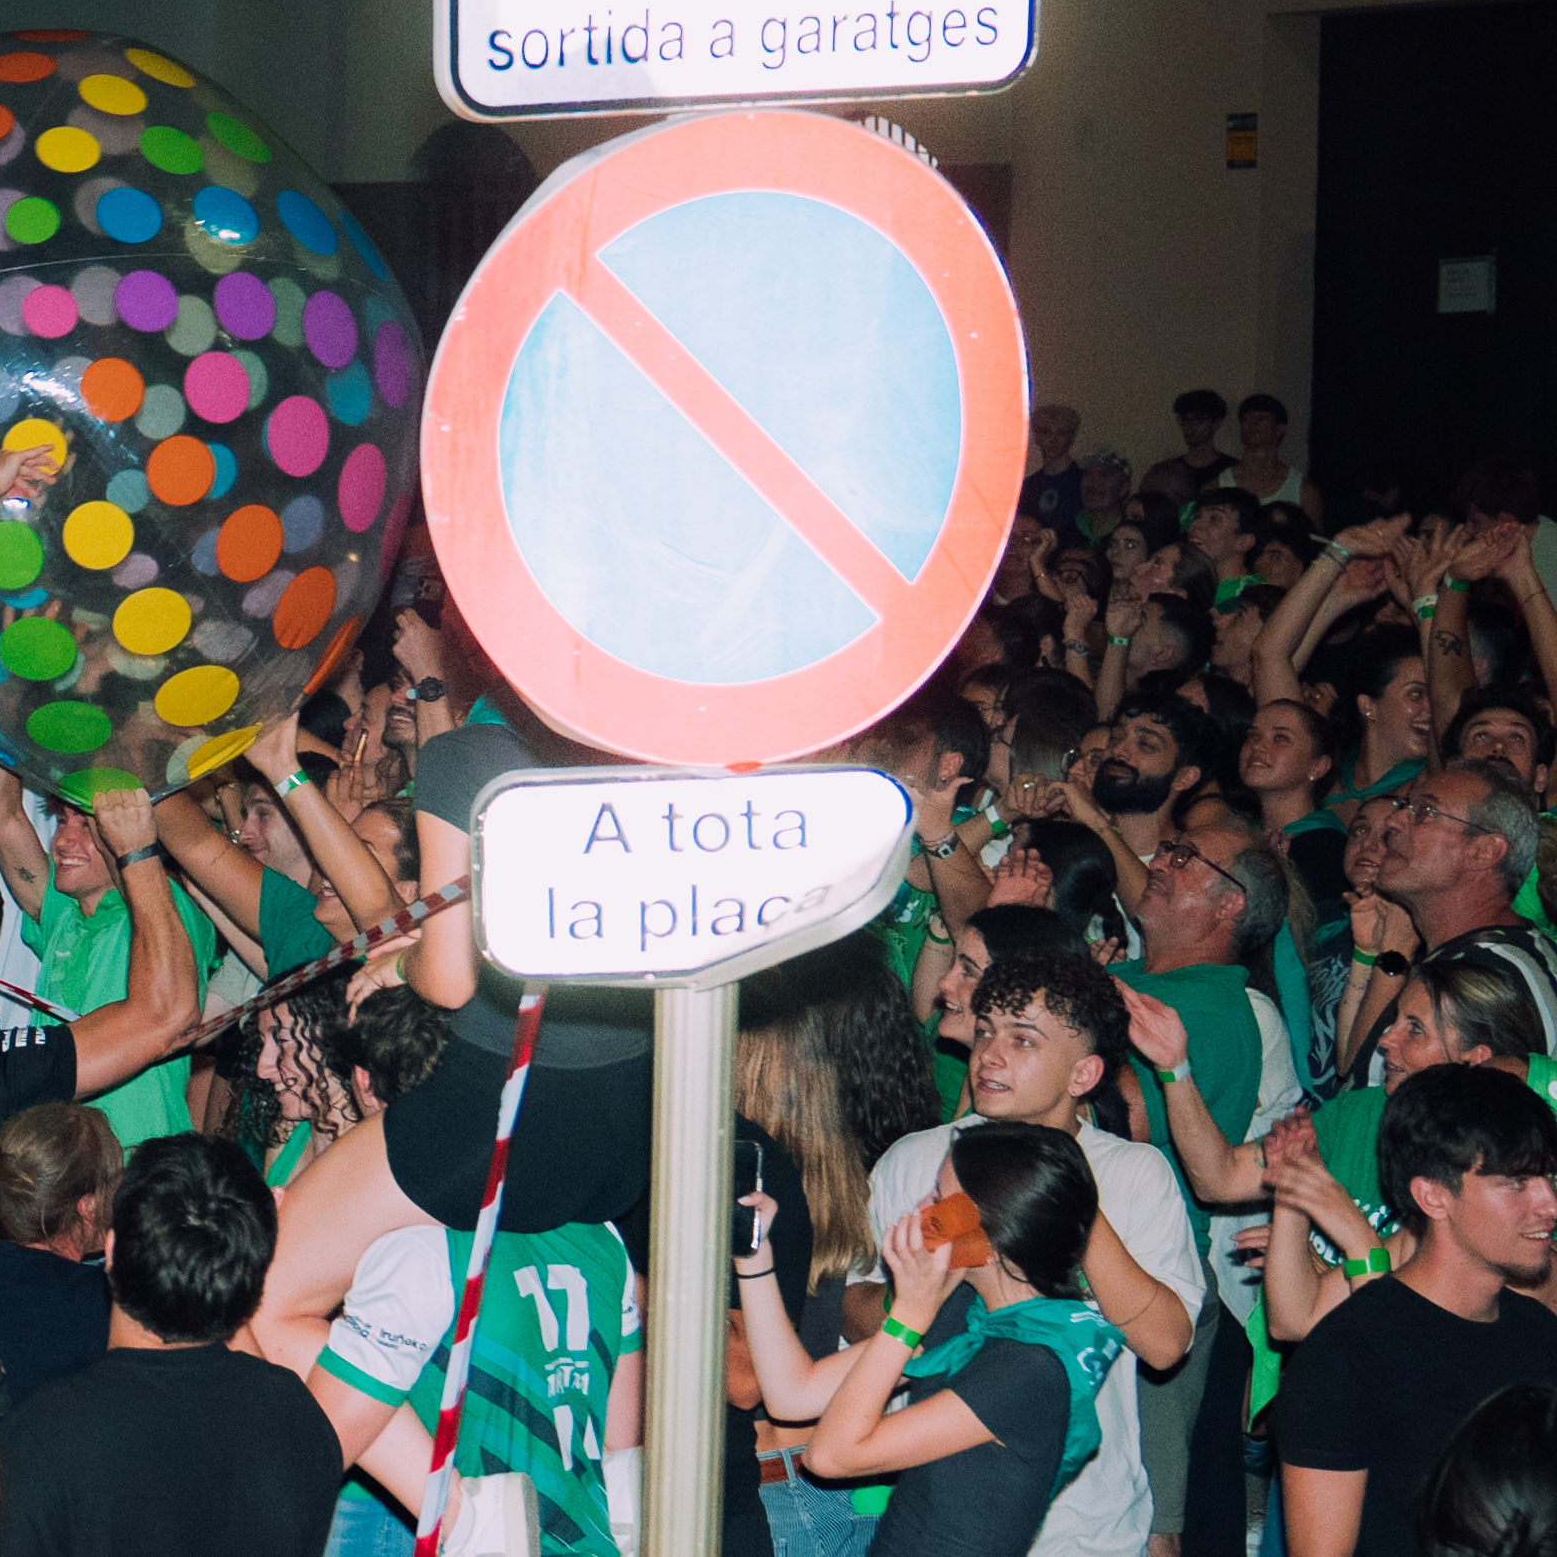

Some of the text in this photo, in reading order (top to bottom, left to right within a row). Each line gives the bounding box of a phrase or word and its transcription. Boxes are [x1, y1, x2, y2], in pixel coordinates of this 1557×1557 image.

[487, 0, 999, 71] sortida a garatges
[583, 799, 808, 854] A tota
[547, 886, 604, 940] la
